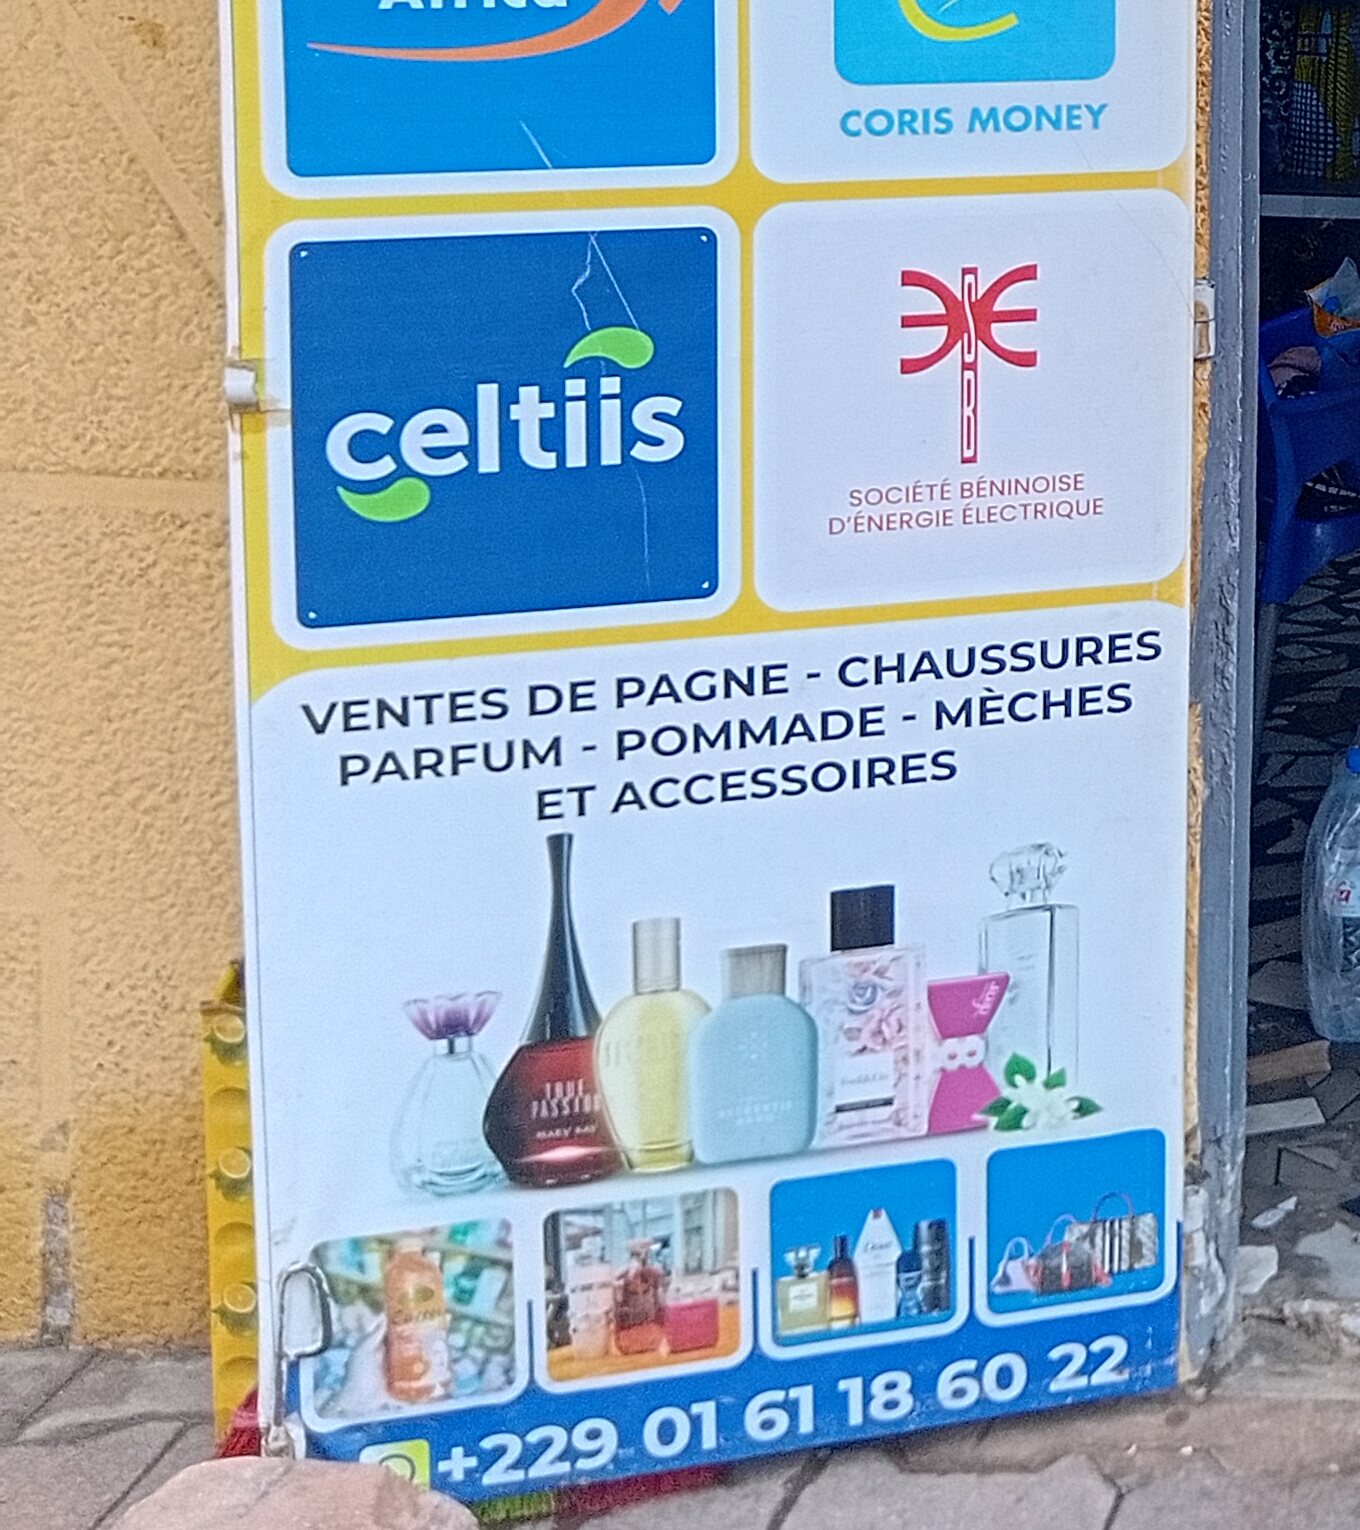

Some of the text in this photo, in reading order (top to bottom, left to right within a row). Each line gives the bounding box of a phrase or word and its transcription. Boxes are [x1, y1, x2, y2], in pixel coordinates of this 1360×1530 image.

[840, 103, 1109, 139] CORIS MONEY
[325, 375, 685, 482] celtiis
[828, 496, 1105, 536] D’ÉNERGIE ÉLECTRIQUE
[848, 470, 1086, 506] SOCIÉTÉ BÉNINOISE
[302, 686, 509, 736] VENTES
[529, 679, 597, 718] DE
[614, 663, 790, 709] PAGNE
[839, 628, 1163, 692] CHAUSSURES
[337, 737, 565, 787] PARFUM
[615, 707, 887, 762] POMMADE
[933, 681, 1134, 731] MÈCHES
[534, 748, 957, 822] ET ACCESSOIRES
[437, 1336, 1130, 1488] +229 01 61 18 60 22
